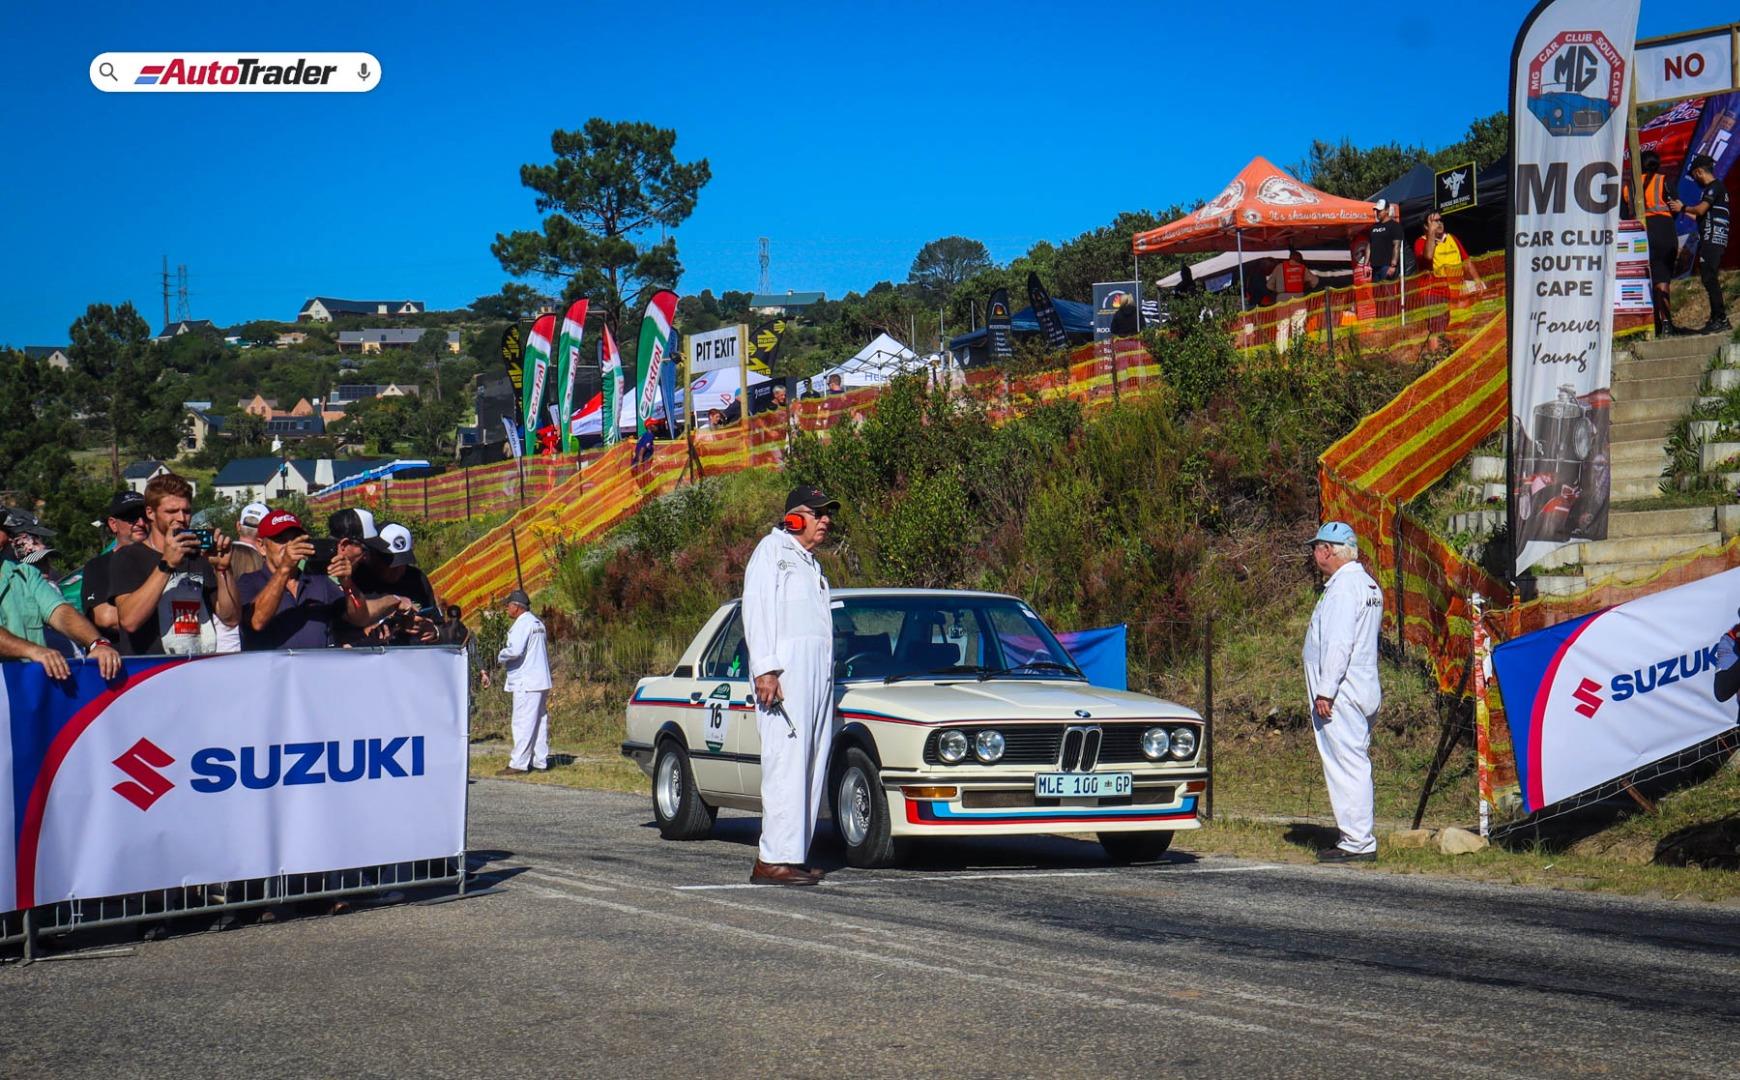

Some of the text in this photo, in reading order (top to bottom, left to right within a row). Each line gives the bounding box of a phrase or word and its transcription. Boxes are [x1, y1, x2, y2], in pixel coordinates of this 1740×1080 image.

[1531, 33, 1622, 102] MG CAR CLUB SOUTH CAPE
[1554, 45, 1598, 92] MG
[1664, 51, 1705, 82] NO
[1517, 161, 1619, 216] MG
[1515, 229, 1614, 248] CAR CLUB
[1531, 255, 1602, 272] SOUTH
[1536, 280, 1593, 297] CAPE
[696, 336, 737, 362] PIT EXIT
[645, 344, 664, 403] Castrol
[1611, 643, 1719, 702] SUZUK
[709, 702, 723, 729] 16
[190, 735, 425, 794] SUZUKI
[1038, 775, 1130, 794] MLE 100 GP
